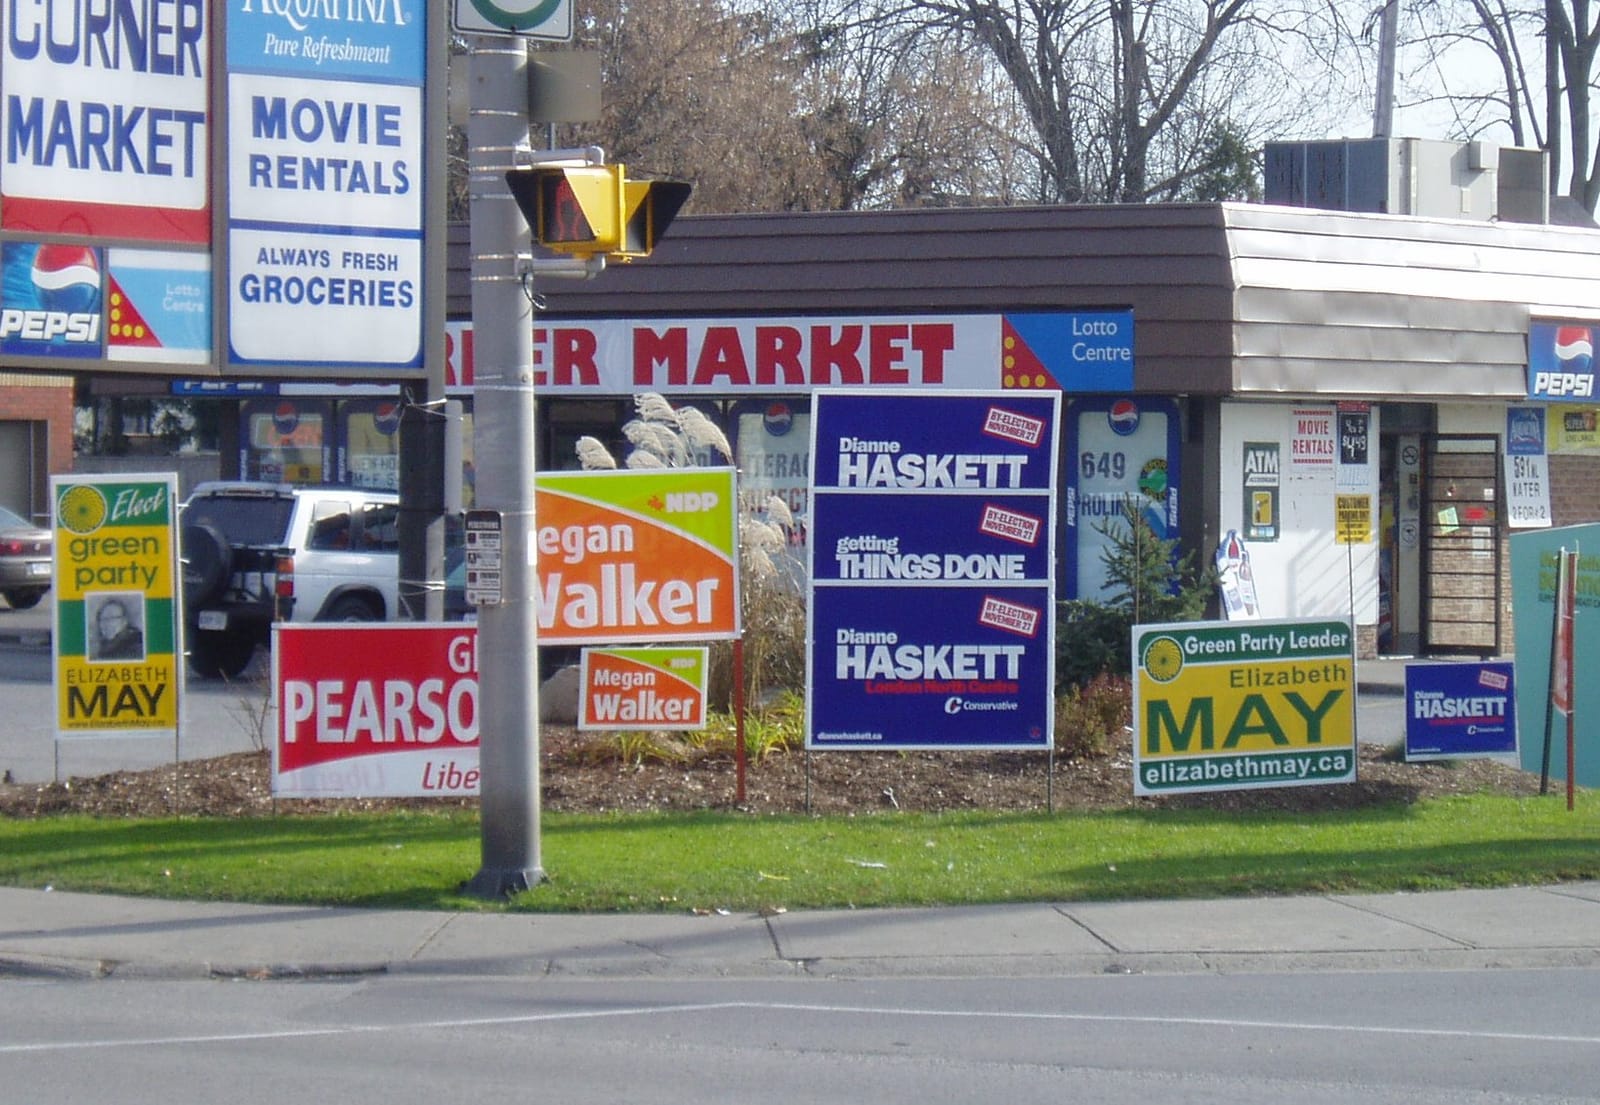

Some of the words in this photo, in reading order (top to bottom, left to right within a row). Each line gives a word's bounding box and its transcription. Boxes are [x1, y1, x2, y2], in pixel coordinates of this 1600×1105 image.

[8, 0, 203, 78] CORNER
[264, 32, 299, 57] Pure
[302, 36, 391, 65] Refreshment
[251, 96, 402, 147] MOVIE
[7, 95, 205, 178] MARKET
[249, 154, 410, 195] RENTALS
[257, 248, 331, 268] ALWAYS
[342, 252, 398, 271] FRESH
[166, 283, 201, 297] Lotto
[240, 274, 414, 308] GROCERIES
[0, 309, 100, 342] PEPSI
[1073, 317, 1118, 336] Lotto
[633, 323, 954, 385] MARKET
[1072, 343, 1131, 361] Centre
[1534, 372, 1594, 397] PEPSI
[1298, 420, 1329, 435] MOVIE
[839, 437, 901, 453] Dianne
[1293, 440, 1334, 454] RENTALS
[838, 454, 1028, 488] HASKETT
[1081, 452, 1126, 479] 649
[1245, 450, 1279, 473] ATM
[111, 487, 163, 522] Elect
[665, 492, 719, 513] NDP
[69, 535, 160, 562] green
[837, 535, 899, 554] getting
[75, 561, 159, 590] party
[836, 554, 942, 579] THINGS
[944, 555, 1025, 579] DONE
[836, 629, 898, 645] Dianne
[1185, 636, 1235, 655] Green
[1241, 633, 1285, 653] Party
[1290, 629, 1348, 649] Leader
[67, 667, 168, 684] ELIZABETH
[836, 646, 1025, 680] HASKETT
[1230, 664, 1347, 688] Elizabeth
[594, 669, 656, 690] Megan
[866, 681, 922, 694] London
[925, 681, 966, 694] North
[68, 683, 166, 718] MAY
[284, 678, 479, 743] PEARSO
[593, 690, 694, 721] Walker
[963, 701, 1018, 711] Conservative
[1415, 697, 1507, 718] HASKETT
[1147, 689, 1345, 754] MAY
[422, 762, 479, 789] Libe
[1146, 755, 1347, 784] elizabethmay.ca
